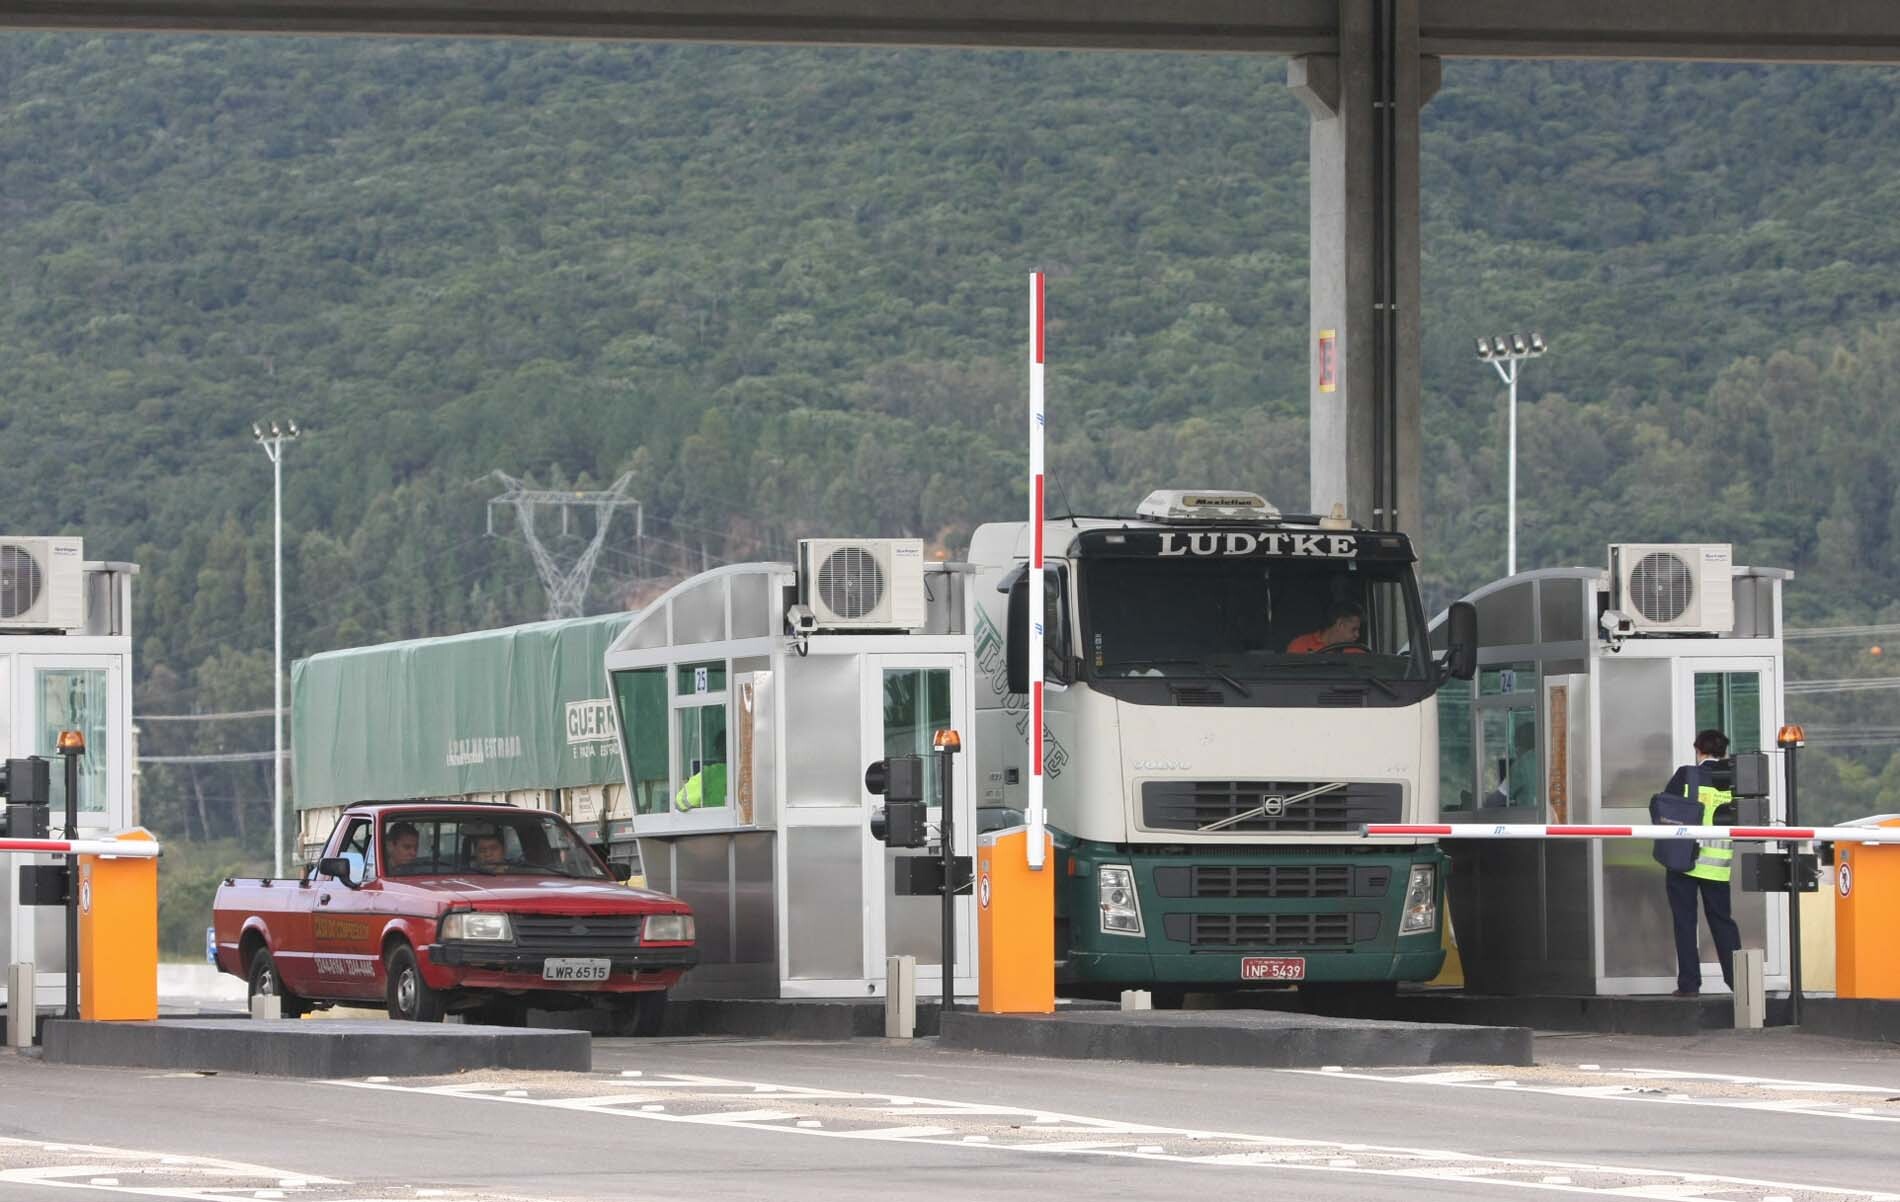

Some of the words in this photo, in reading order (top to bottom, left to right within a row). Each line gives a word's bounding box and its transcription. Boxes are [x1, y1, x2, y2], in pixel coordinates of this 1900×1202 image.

[1157, 532, 1359, 558] LUDTKE
[696, 670, 706, 691] 25
[1501, 672, 1513, 693] 24
[568, 704, 618, 737] GUERR
[545, 967, 573, 979] LWR
[575, 966, 607, 979] 6515
[1246, 964, 1269, 977] INP
[1271, 964, 1301, 977] 5439
